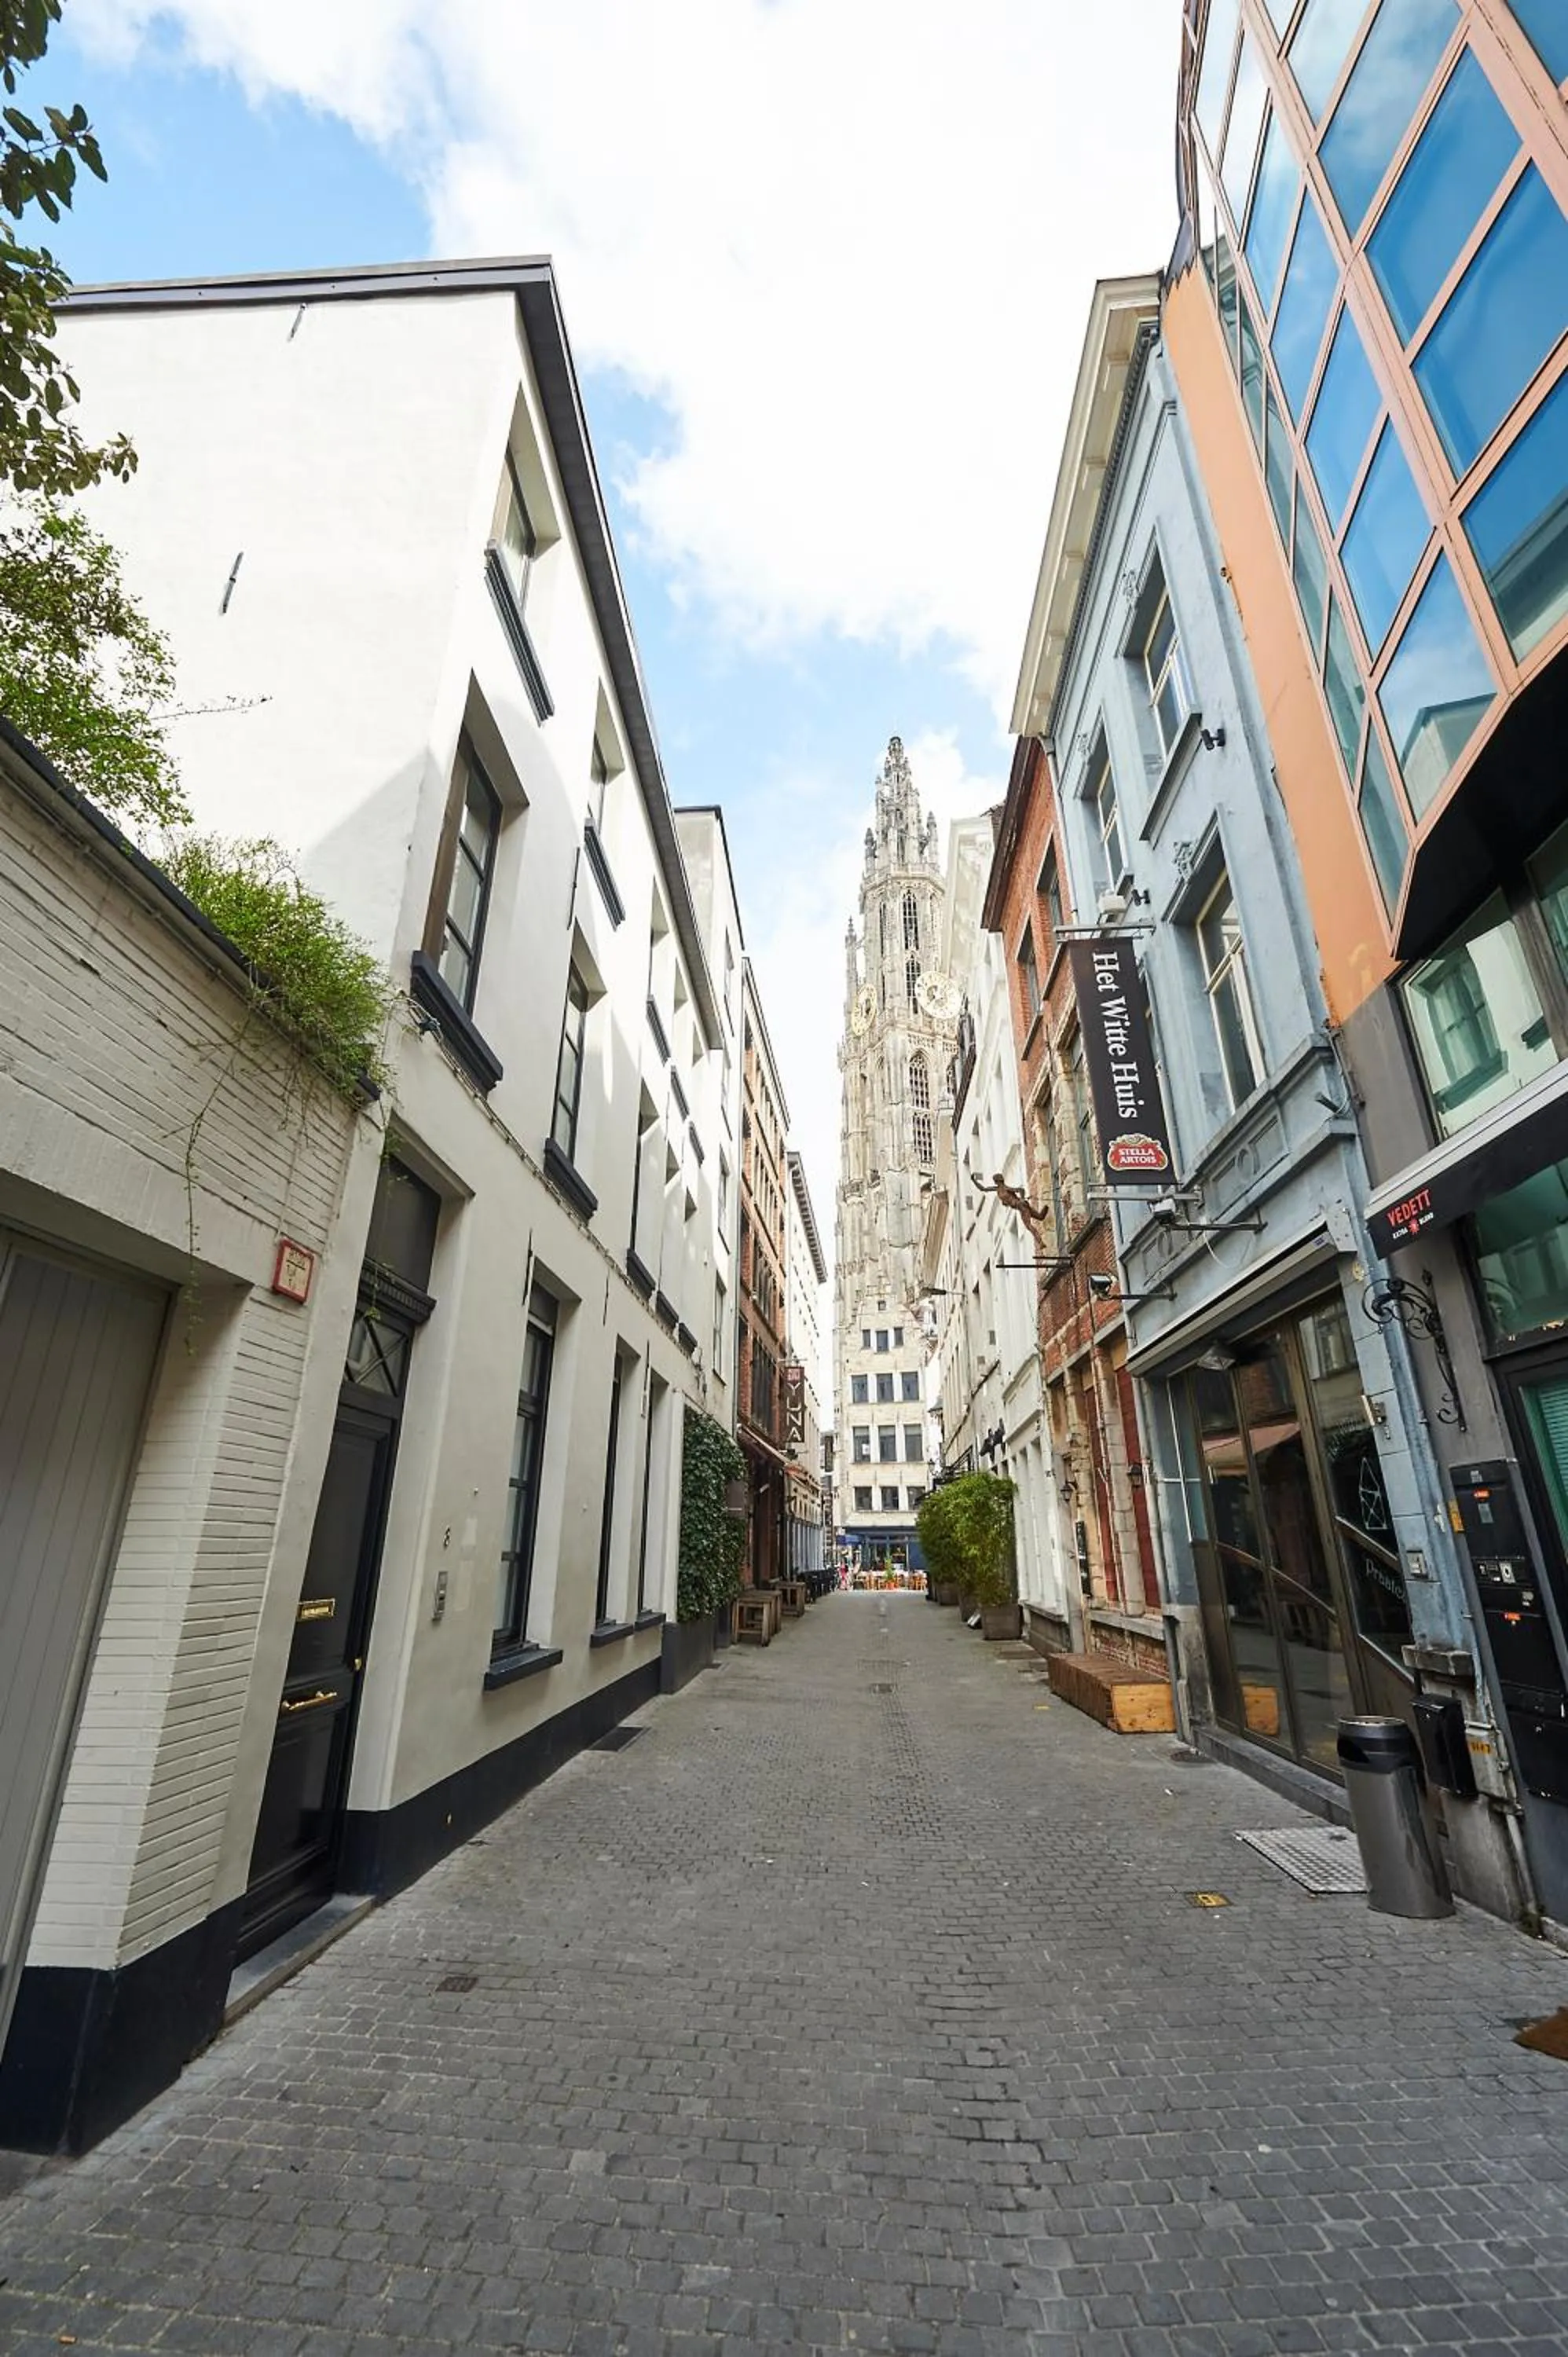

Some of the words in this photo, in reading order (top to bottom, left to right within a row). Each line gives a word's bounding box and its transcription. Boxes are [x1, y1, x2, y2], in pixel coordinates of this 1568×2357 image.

[1093, 951, 1119, 992] Het
[1100, 995, 1130, 1057] Witte
[1111, 1061, 1145, 1119] Huis
[1387, 1189, 1431, 1226] VEDETT
[786, 1383, 801, 1441] YUNA
